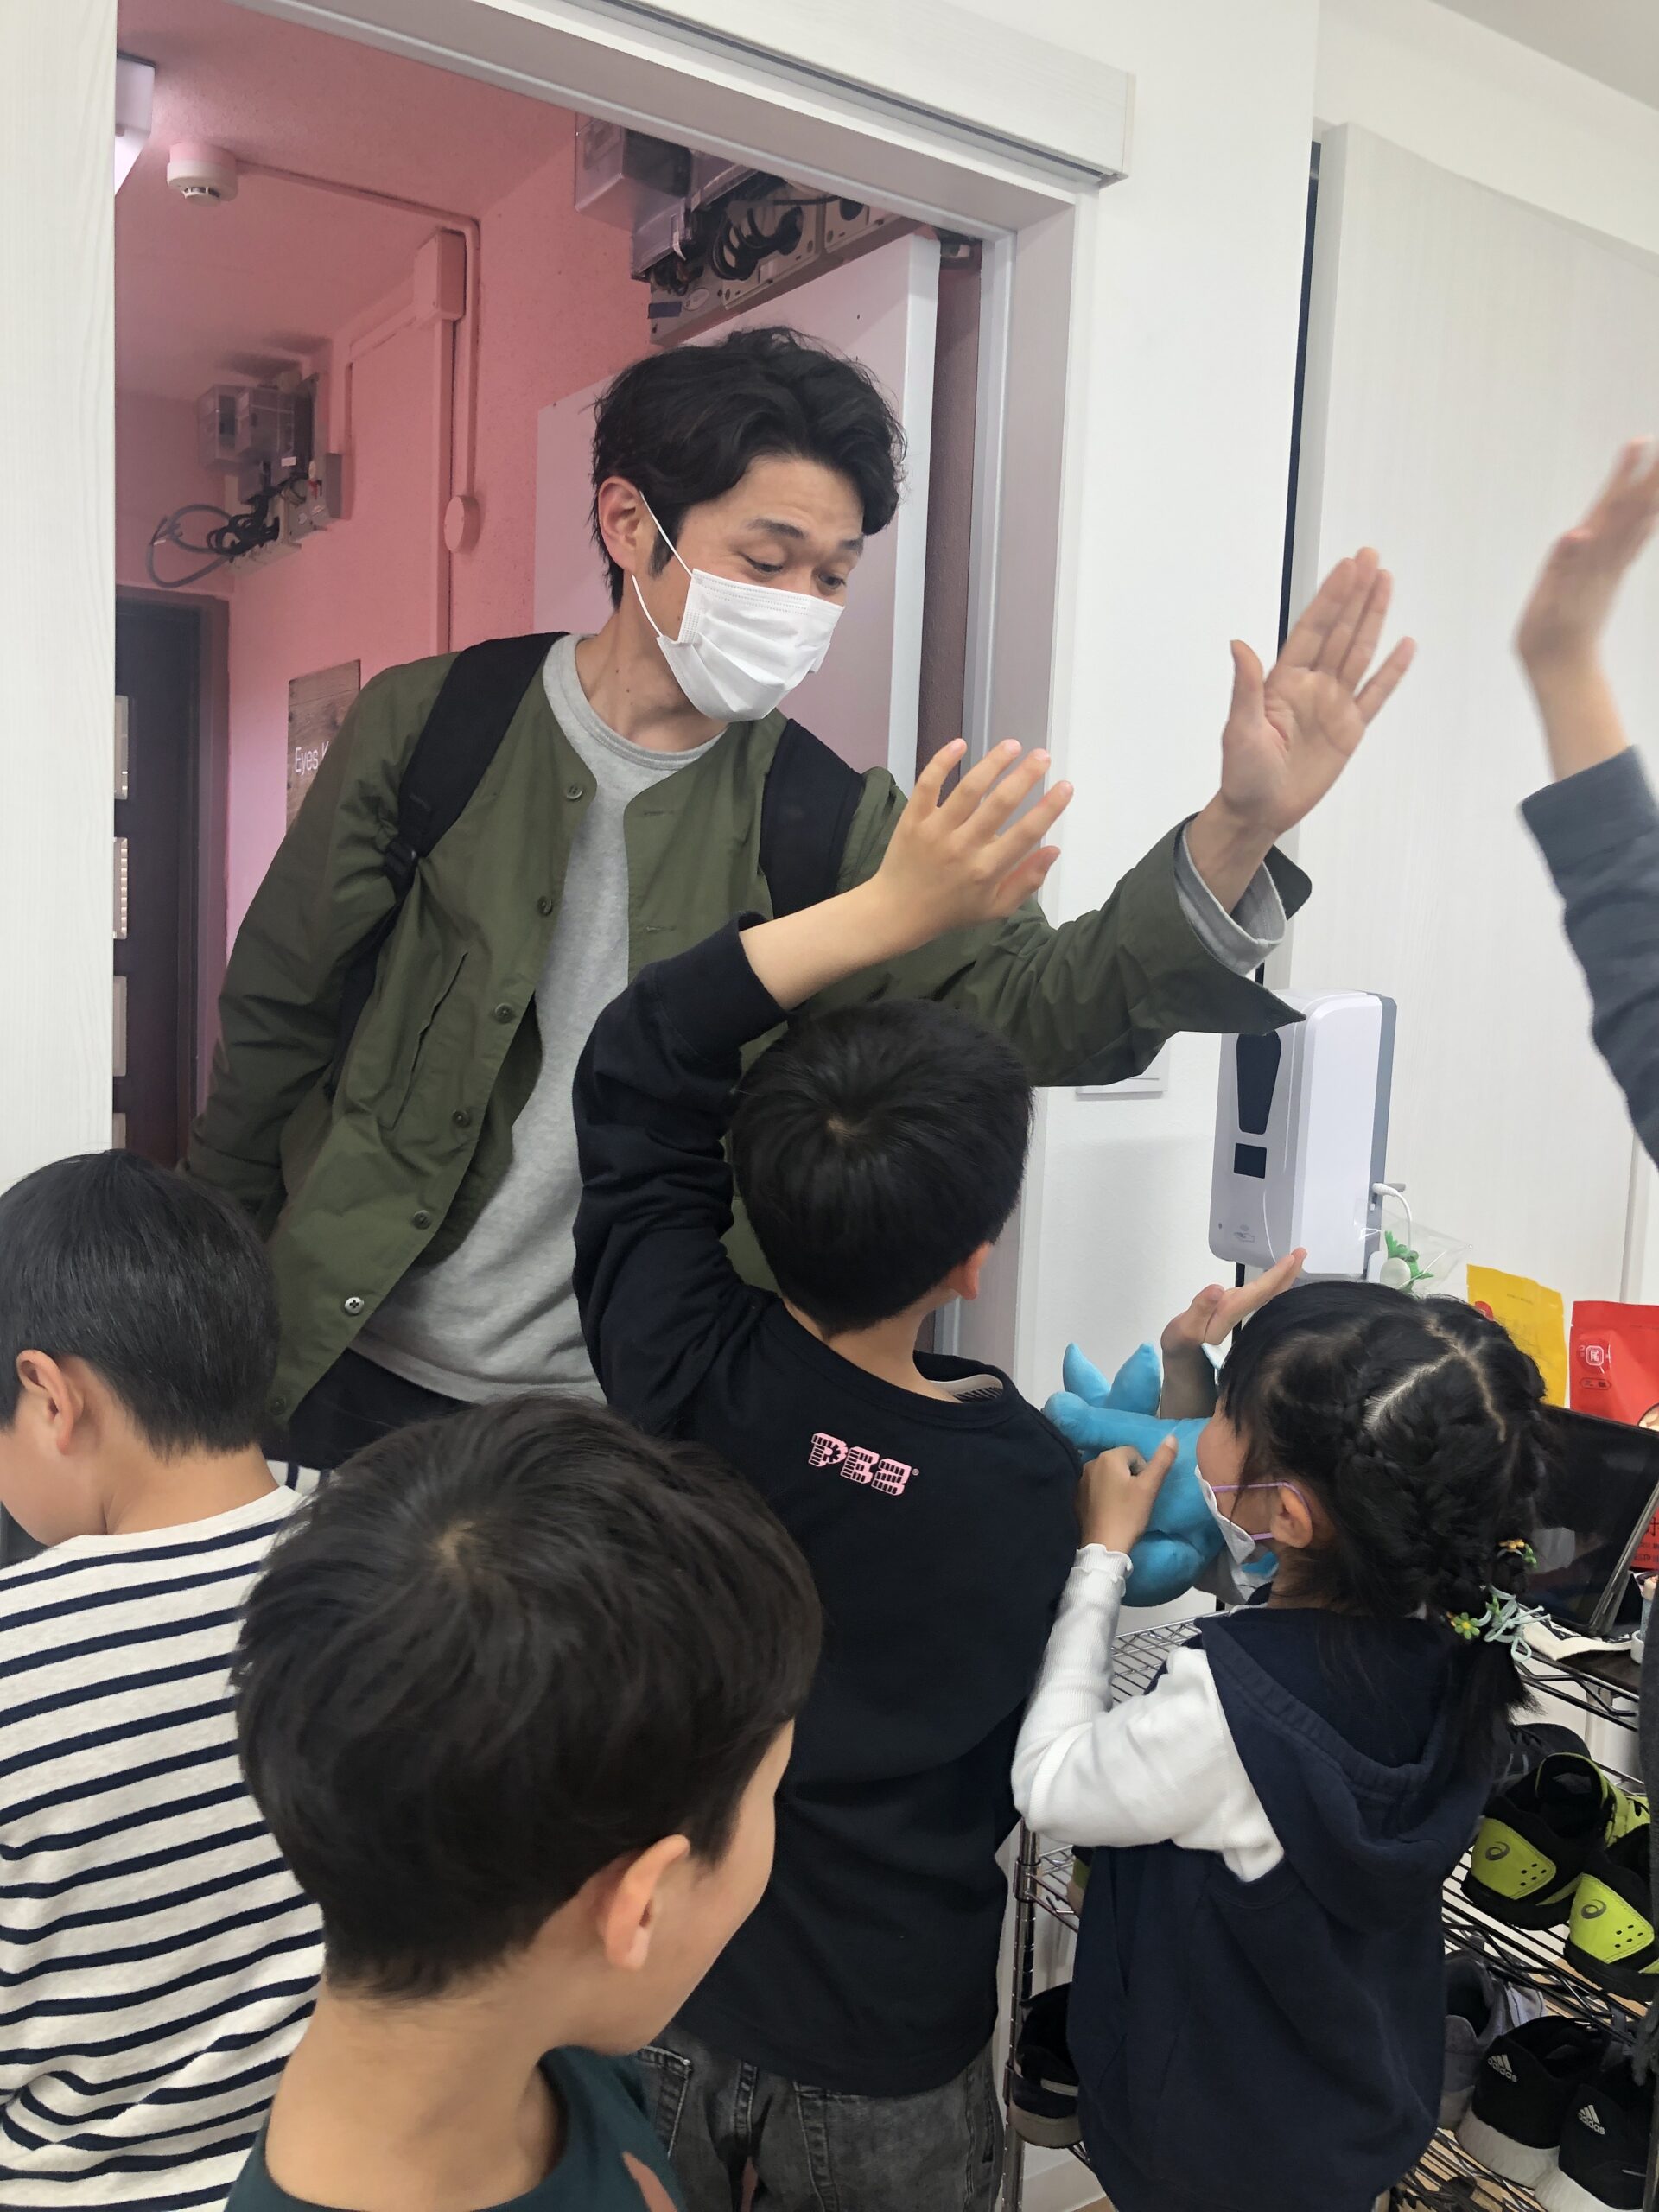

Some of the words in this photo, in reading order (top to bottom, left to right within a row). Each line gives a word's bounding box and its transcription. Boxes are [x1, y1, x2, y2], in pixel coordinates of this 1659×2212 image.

[295, 747, 319, 776] Eyes
[1487, 2057, 1517, 2082] adidas
[1578, 2112, 1605, 2135] adidas
